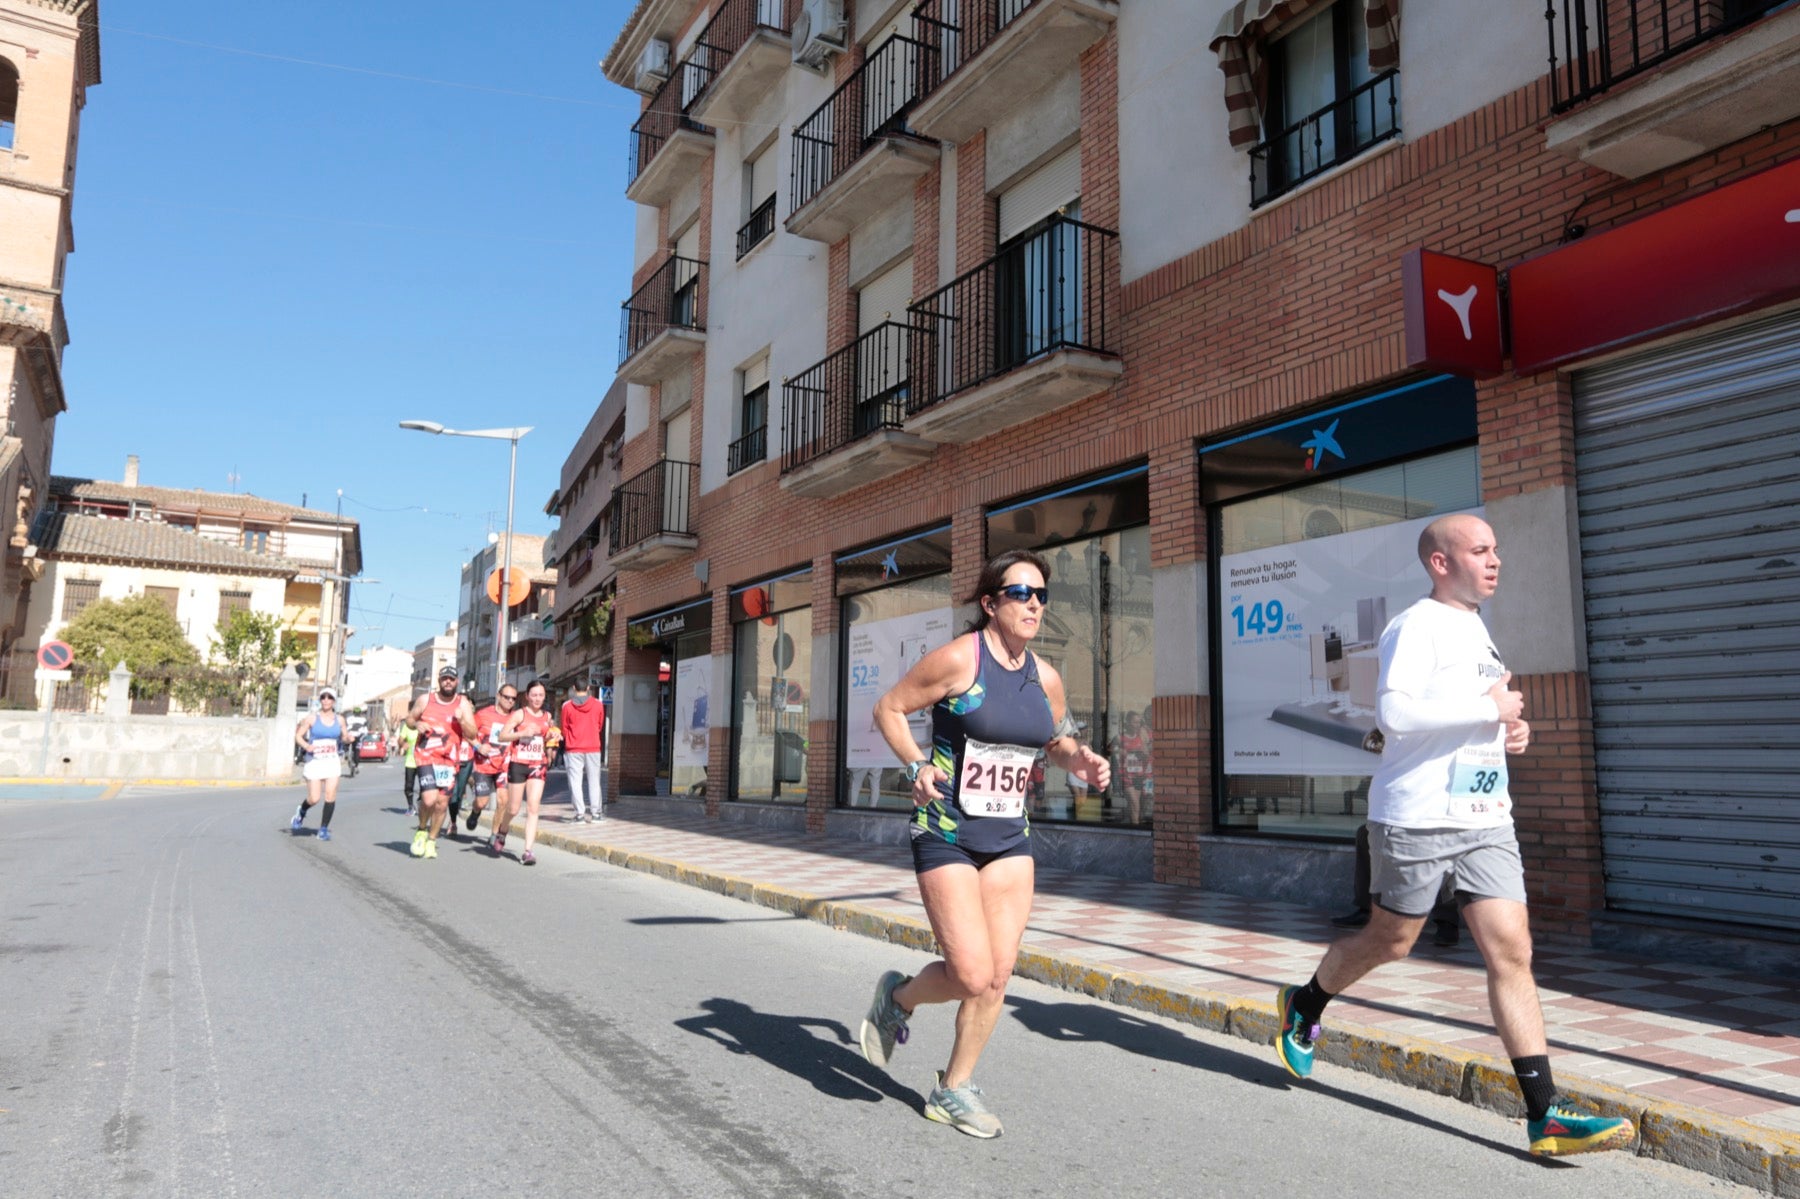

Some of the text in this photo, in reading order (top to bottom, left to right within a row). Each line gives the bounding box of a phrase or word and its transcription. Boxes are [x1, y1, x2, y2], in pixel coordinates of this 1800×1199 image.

[1230, 560, 1297, 577] Renueva tu hogar,
[1230, 577, 1260, 588] renueva
[1262, 575, 1270, 583] tu
[1231, 594, 1242, 603] por
[1231, 599, 1284, 638] 149
[1286, 623, 1303, 632] mes
[966, 762, 1028, 793] 2156
[1469, 770, 1499, 794] 38
